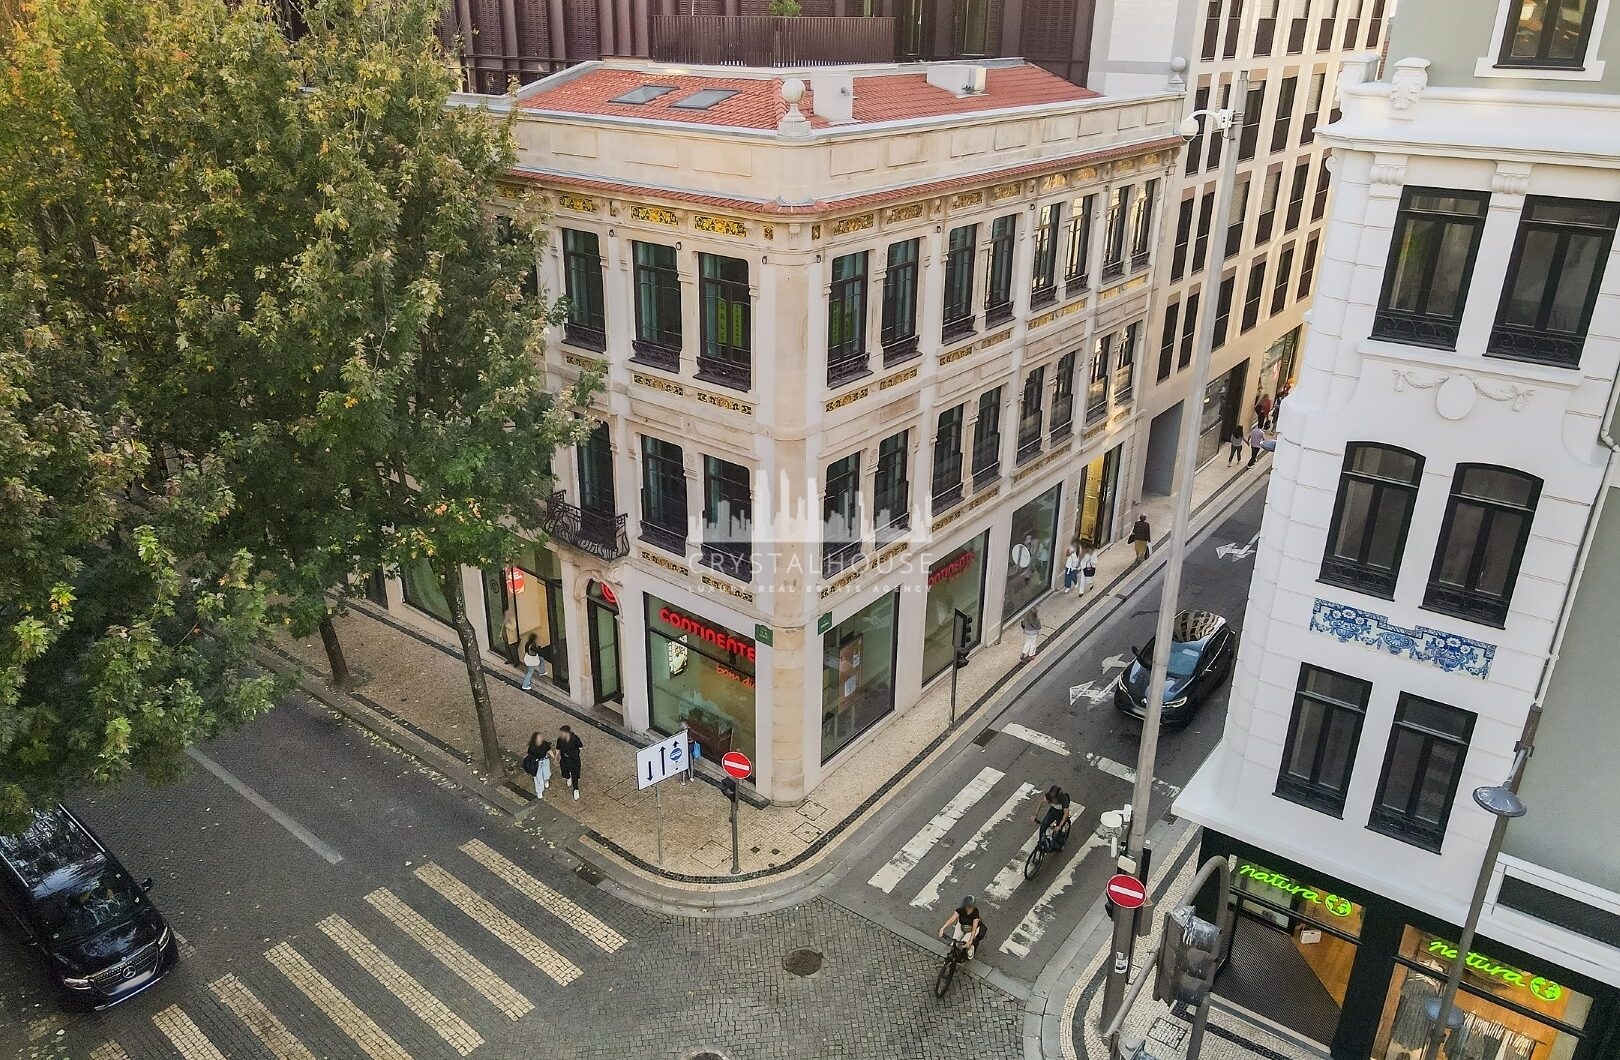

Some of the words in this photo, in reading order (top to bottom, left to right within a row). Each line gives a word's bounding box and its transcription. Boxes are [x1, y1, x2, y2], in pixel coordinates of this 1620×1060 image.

[658, 607, 755, 664] CONTINENTE
[716, 663, 740, 681] bom
[742, 677, 755, 689] di
[1240, 864, 1321, 904] natura
[1428, 940, 1527, 987] natura
